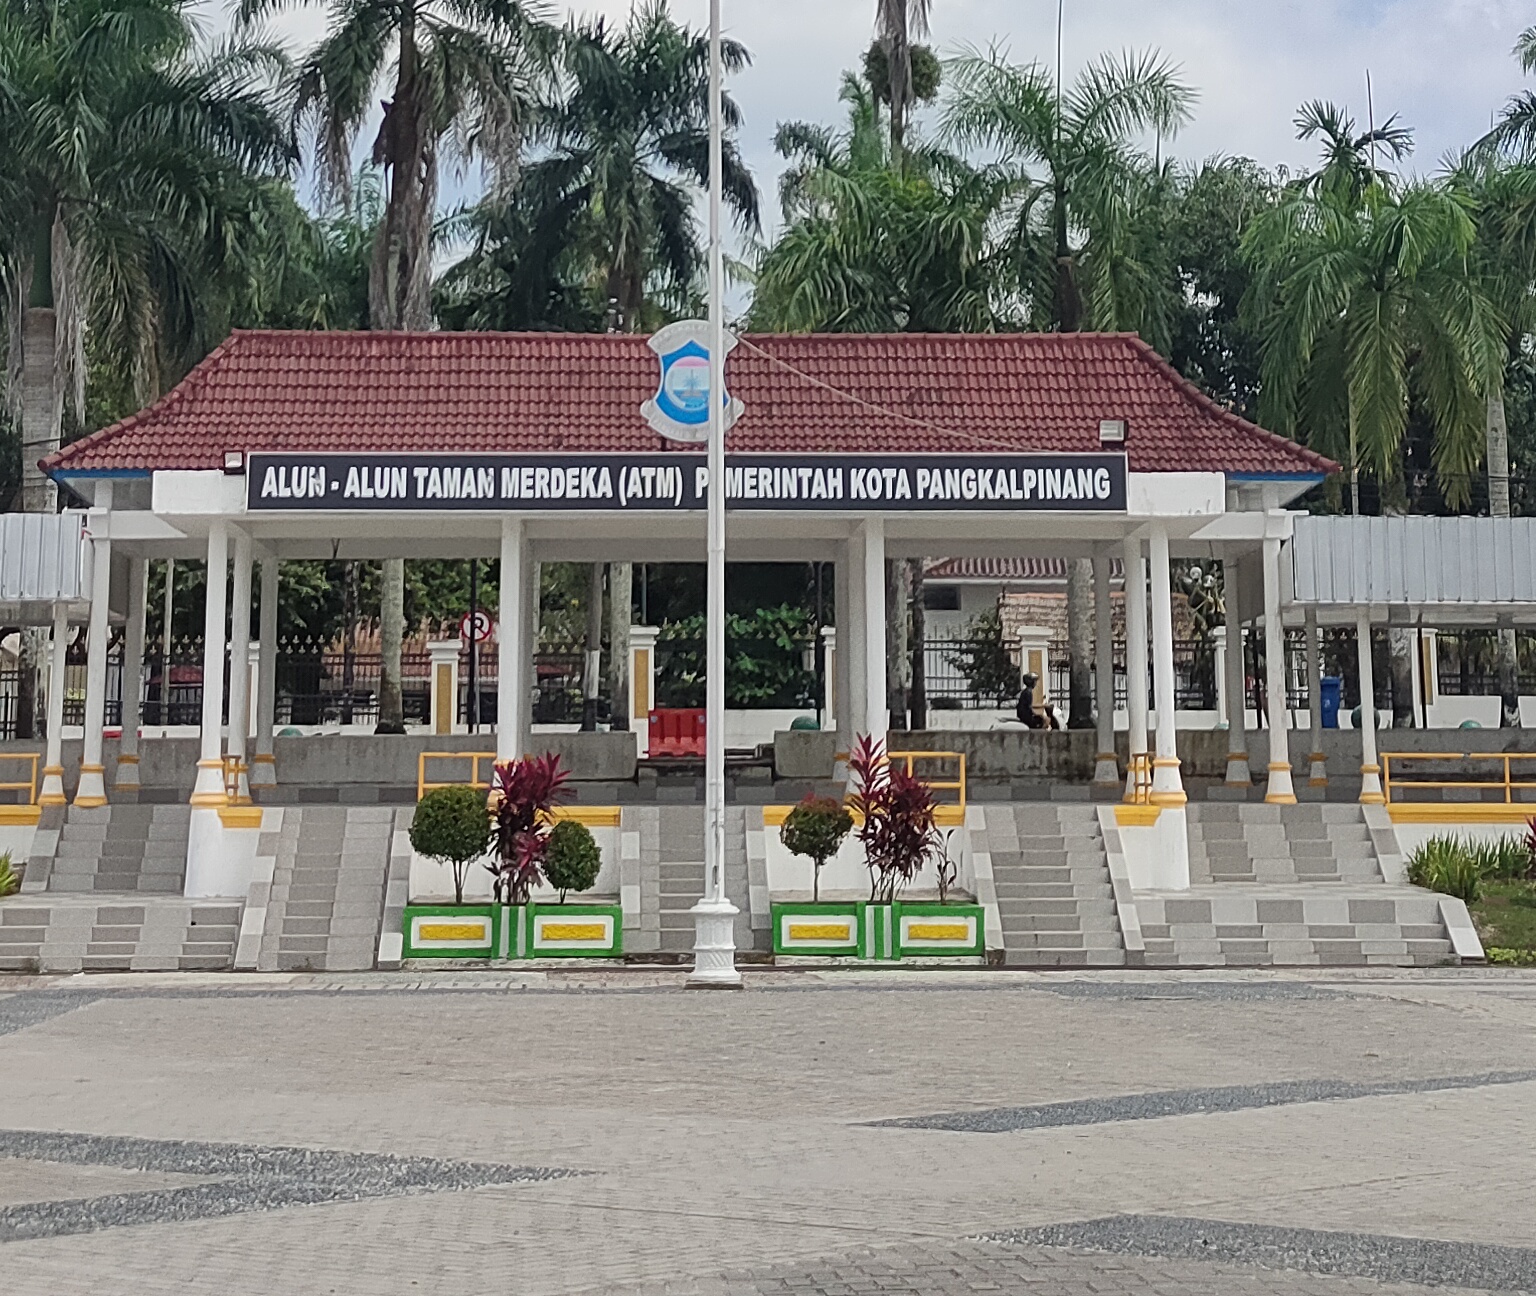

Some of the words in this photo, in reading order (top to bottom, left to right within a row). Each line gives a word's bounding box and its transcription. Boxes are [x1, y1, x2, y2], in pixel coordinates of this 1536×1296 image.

[261, 466, 326, 498] ALUN
[343, 466, 408, 499] ALUN
[413, 467, 495, 499] TAMAN
[500, 467, 614, 499] MERDEKA
[618, 465, 683, 507] (ATM)
[695, 466, 843, 500] PMERINTAH
[850, 467, 912, 500] KOTA
[916, 467, 1111, 500] PANGKALPINANG
